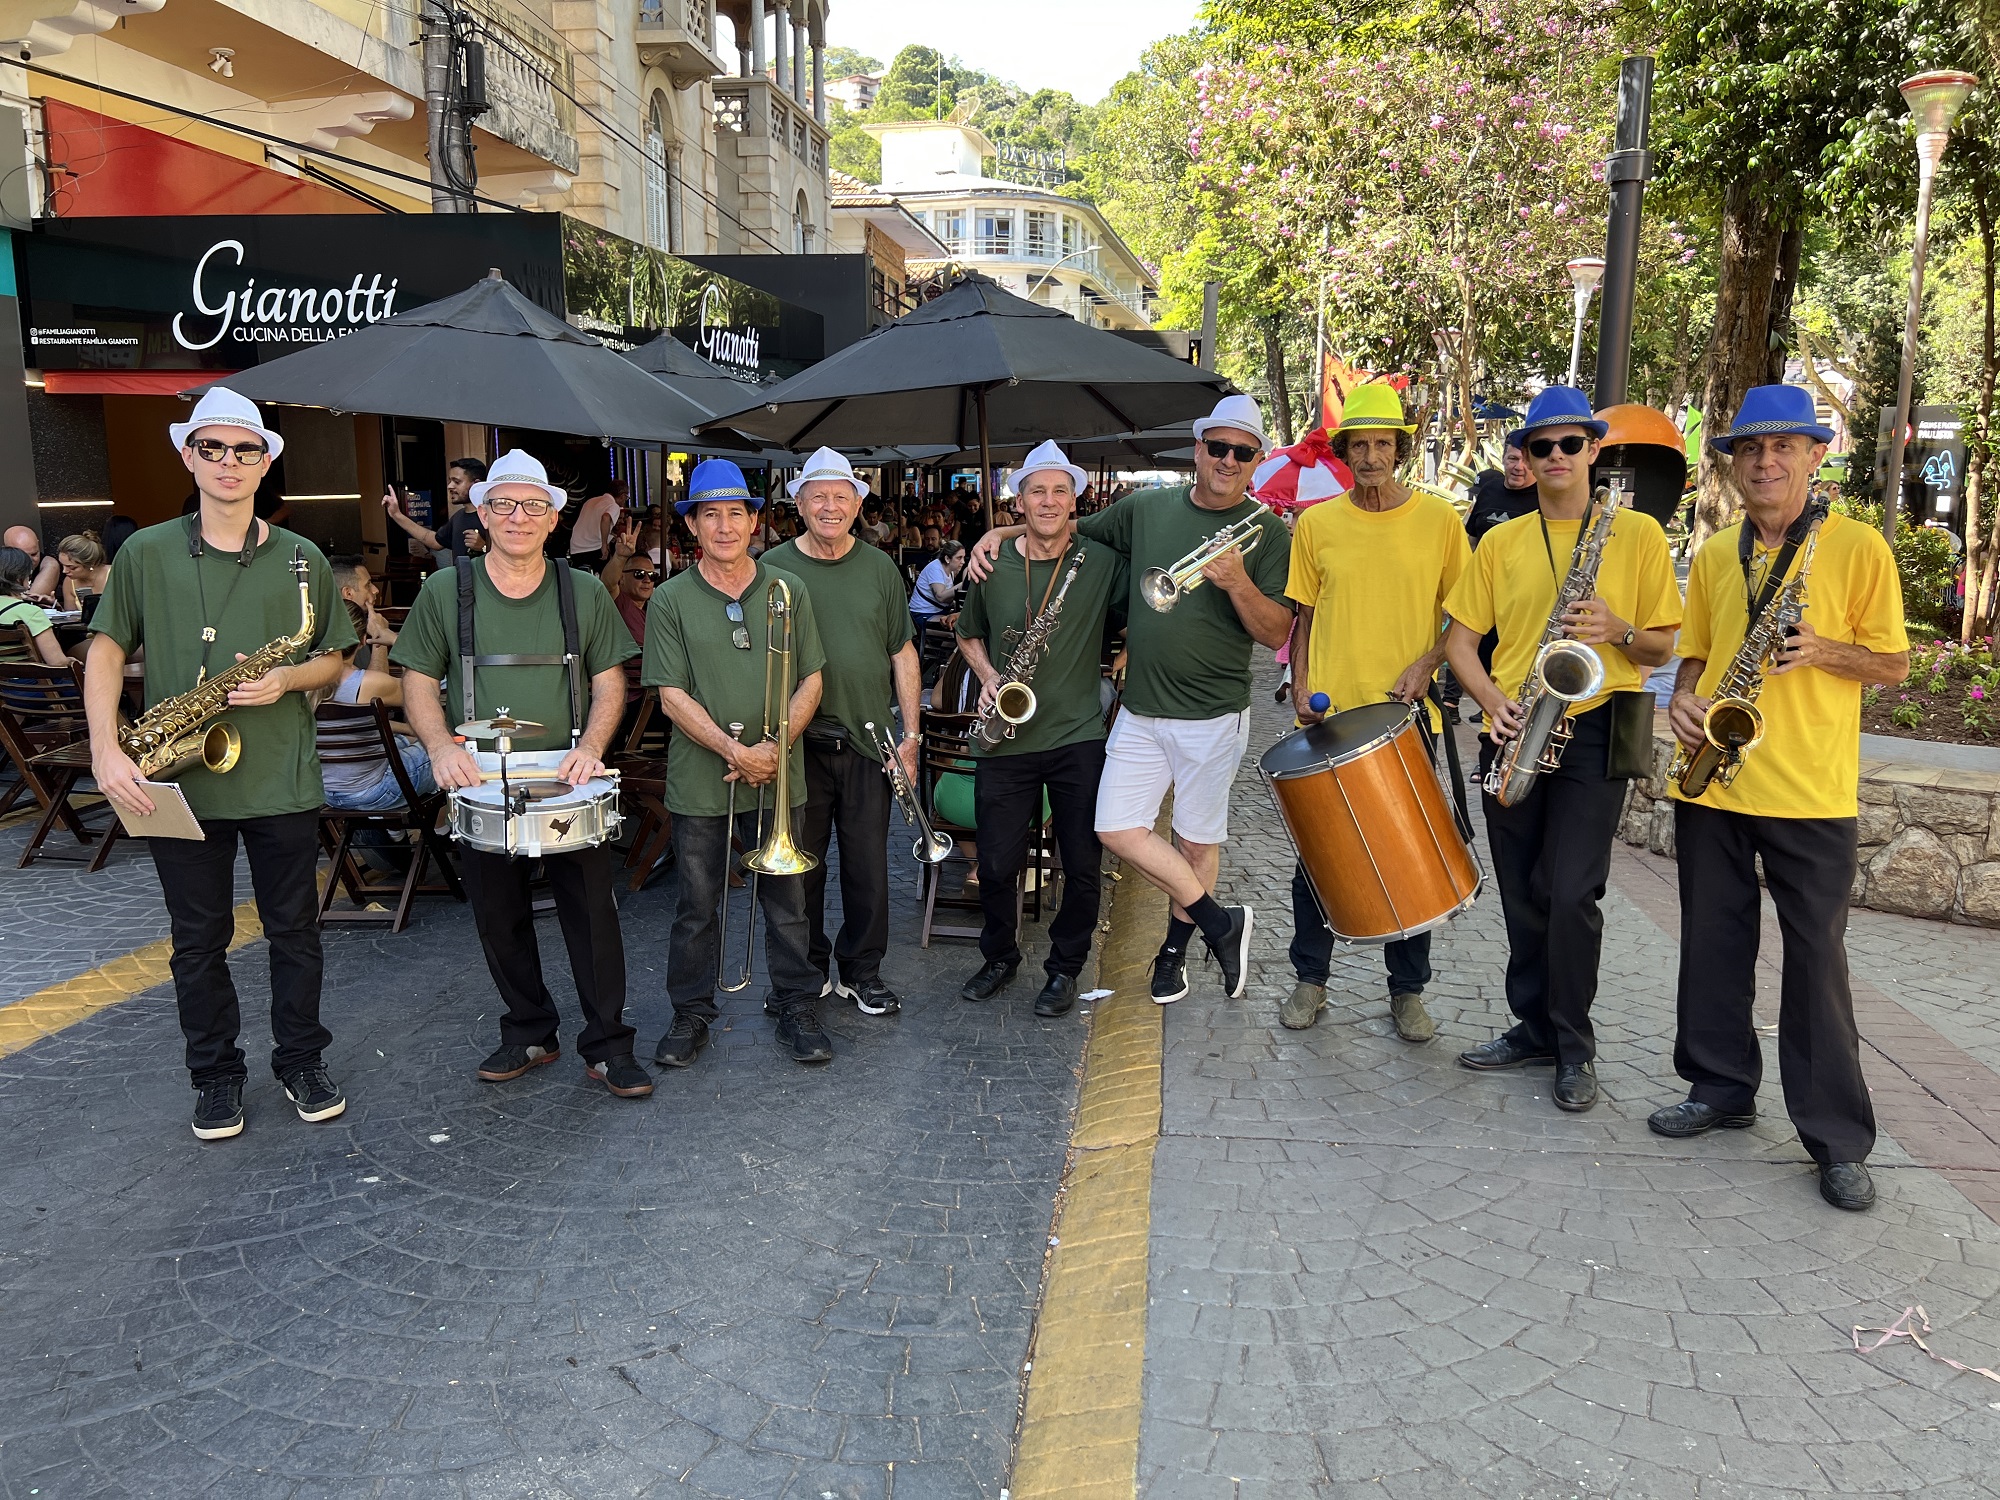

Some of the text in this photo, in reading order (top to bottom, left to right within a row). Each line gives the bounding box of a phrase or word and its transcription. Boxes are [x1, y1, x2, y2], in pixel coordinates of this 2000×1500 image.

[172, 240, 398, 350] Gianotti
[39, 336, 139, 345] RESTAURANTE FAMÍLIA GIANOTTI
[233, 327, 289, 342] CUCINA
[291, 327, 336, 342] DELLA
[694, 284, 760, 369] Gianotti
